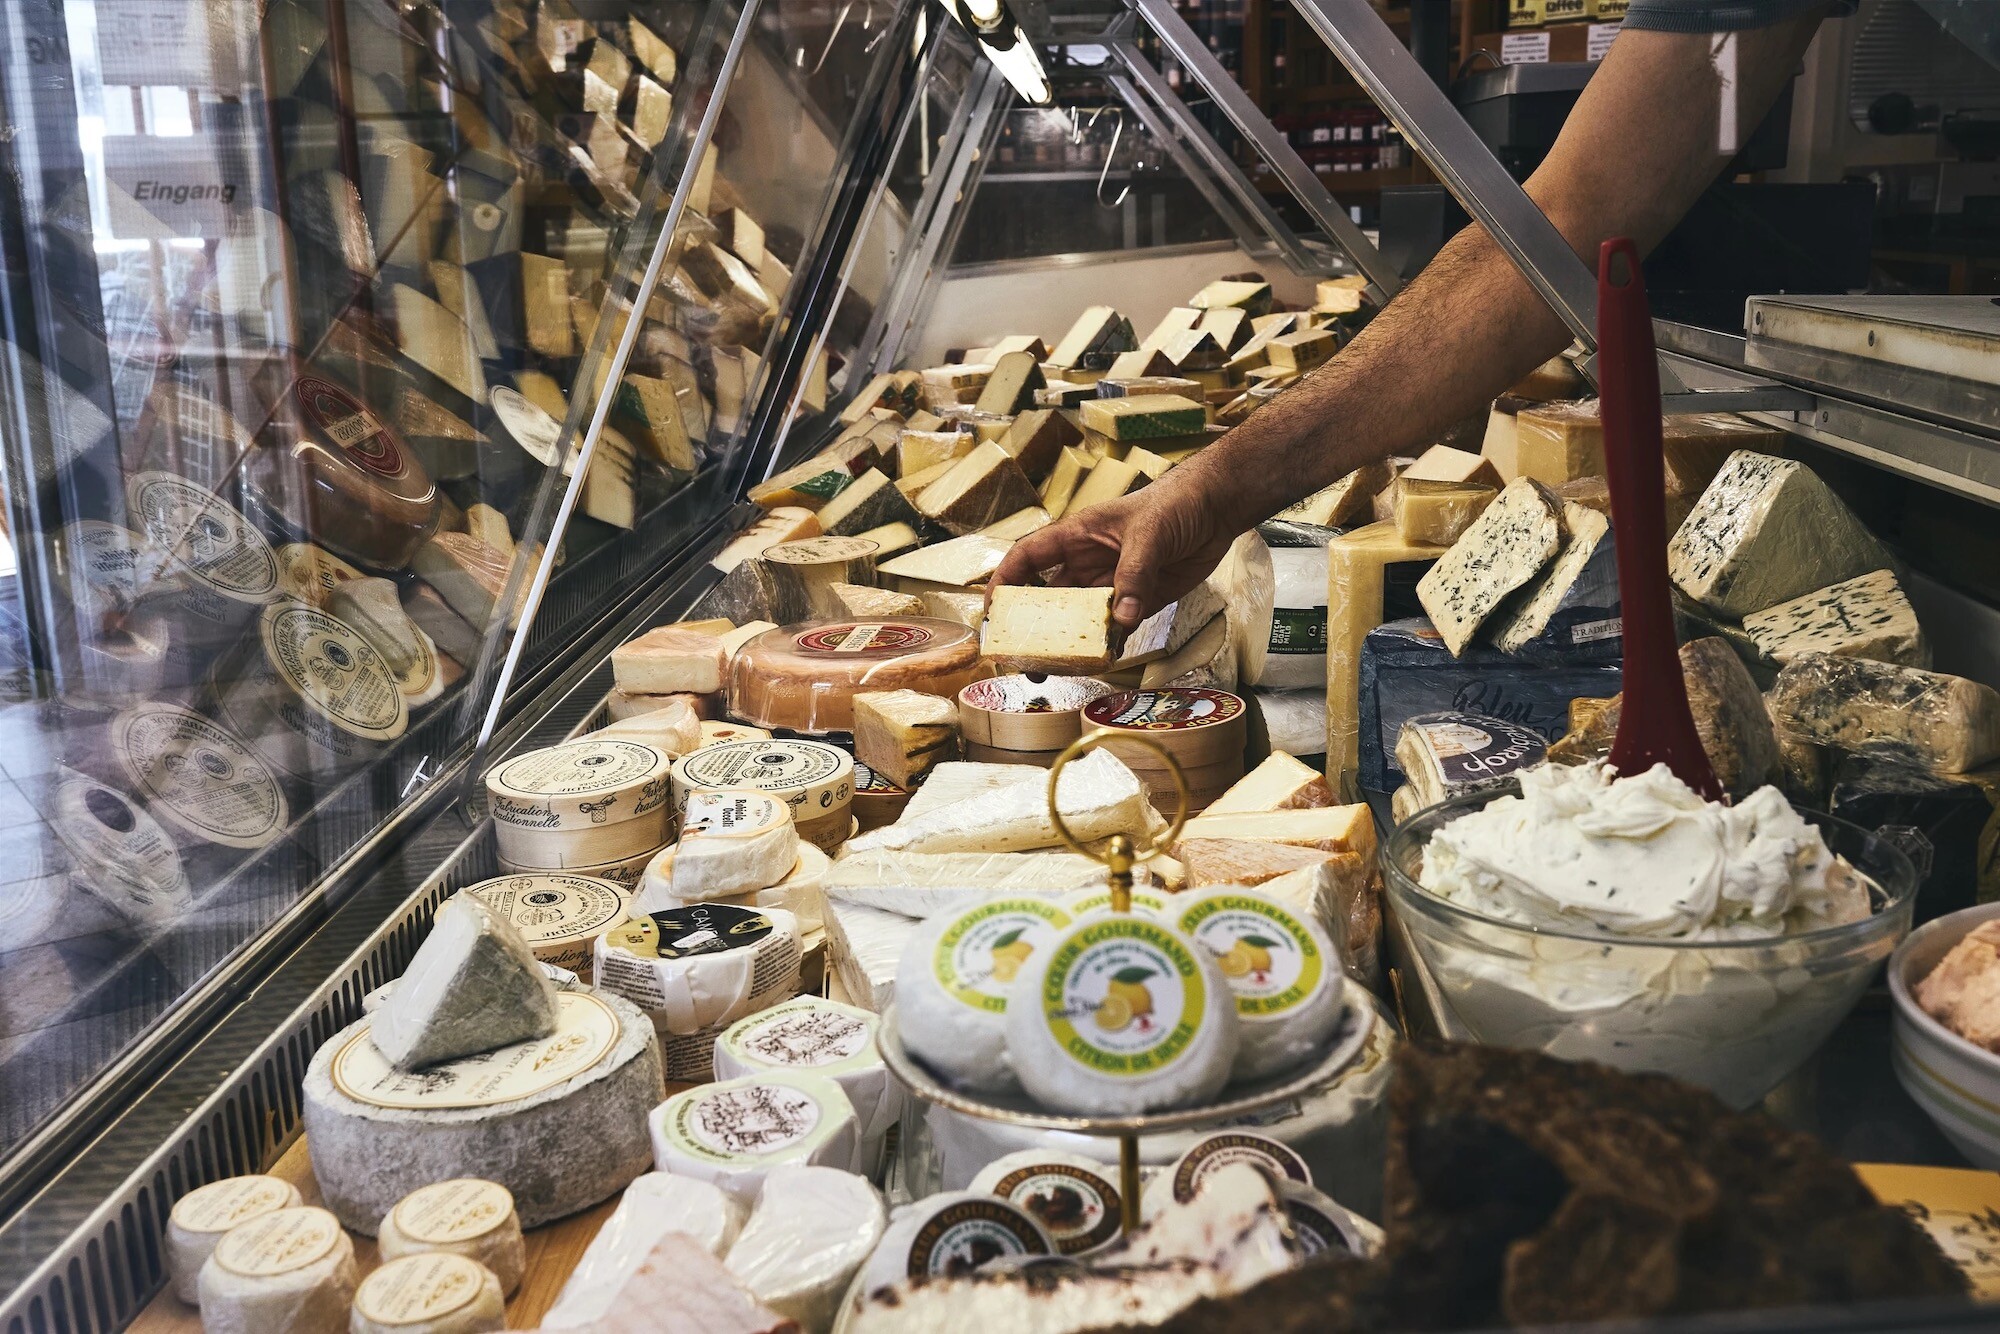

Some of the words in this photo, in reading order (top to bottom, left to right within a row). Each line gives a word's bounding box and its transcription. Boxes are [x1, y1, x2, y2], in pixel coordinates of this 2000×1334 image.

[134, 181, 237, 205] Eingang
[1271, 619, 1281, 644] DUTCH
[1278, 625, 1286, 644] GOAT
[1452, 679, 1546, 724] Bleu
[1185, 717, 1219, 729] AOP
[494, 795, 552, 817] Fabrication
[735, 799, 747, 821] Robiola
[493, 808, 562, 829] traditionnelle
[722, 807, 735, 828] Occelli
[550, 877, 612, 900] CAMEMBERT
[541, 910, 609, 938] NORMANDIE
[1082, 921, 1195, 977] GOURMAND
